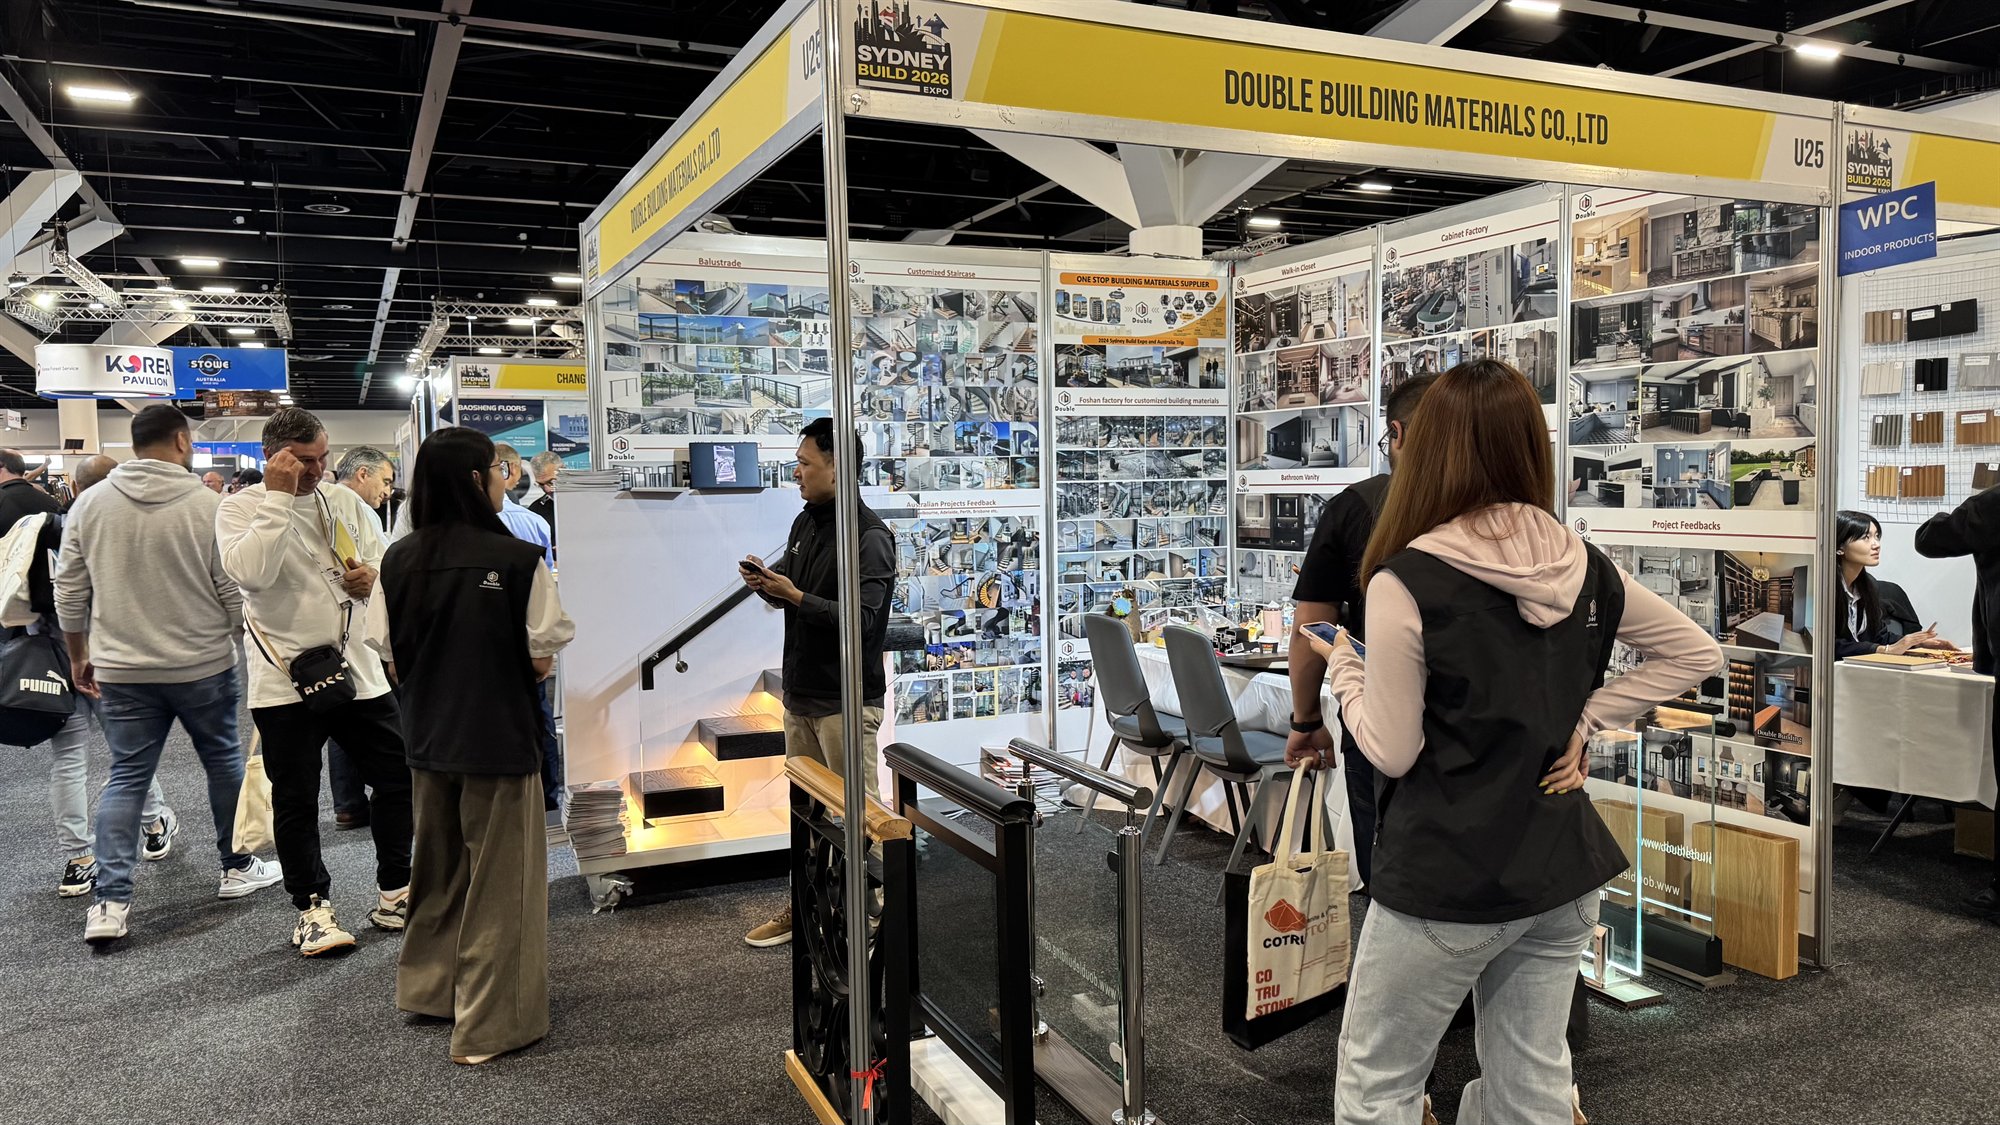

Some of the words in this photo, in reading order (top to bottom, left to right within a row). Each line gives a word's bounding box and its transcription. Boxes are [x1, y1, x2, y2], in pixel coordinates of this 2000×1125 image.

[857, 44, 949, 71] SYDNEY
[858, 63, 908, 80] BUILD
[911, 70, 949, 85] 2026
[923, 86, 949, 96] EXPO
[1225, 68, 1313, 113] DOUBLE
[1320, 80, 1418, 124] BUILDING
[1425, 93, 1536, 138] MATERIALS
[1540, 108, 1609, 147] CO.,LTD
[1794, 137, 1824, 169] U25
[1847, 161, 1892, 178] SYDNEY
[1847, 175, 1871, 186] BUILD
[1872, 177, 1891, 188] 2026
[630, 197, 647, 234] DOUBLE
[647, 177, 668, 220] BUILDING
[668, 148, 698, 201] MATERIALS
[1575, 210, 1596, 220] Double
[1857, 195, 1918, 231] WPC
[1441, 230, 1464, 242] Cabinet
[1465, 224, 1489, 239] Factory
[1844, 244, 1882, 260] INDOOR
[1884, 232, 1935, 252] PRODUCTS
[698, 257, 742, 268] Balustrade
[1281, 266, 1300, 276] Walk-in
[1300, 262, 1316, 272] Closet
[1383, 261, 1400, 270] Double
[907, 267, 946, 277] Customized
[946, 269, 976, 278] Staircase
[1092, 276, 1110, 284] STOP
[1111, 277, 1142, 285] BUILDING
[1144, 278, 1180, 287] MATERIALS
[1181, 280, 1210, 288] SUPPLIER
[105, 354, 172, 376] KOREA
[190, 360, 229, 369] STOWE
[122, 375, 168, 387] PAVILION
[458, 404, 496, 412] BAOSHENG
[1102, 397, 1123, 406] factory
[1168, 397, 1192, 406] building
[1280, 474, 1304, 482] Bathroom
[1304, 474, 1320, 482] Vanity
[940, 500, 966, 509] Projects
[1652, 520, 1679, 531] Project
[1680, 520, 1720, 531] Feedbacks
[20, 678, 62, 696] PUMA
[1757, 730, 1777, 738] Double
[1778, 732, 1802, 744] Building
[1256, 968, 1272, 984] CO
[1256, 984, 1280, 1002] TRU
[1255, 997, 1294, 1018] STONE
